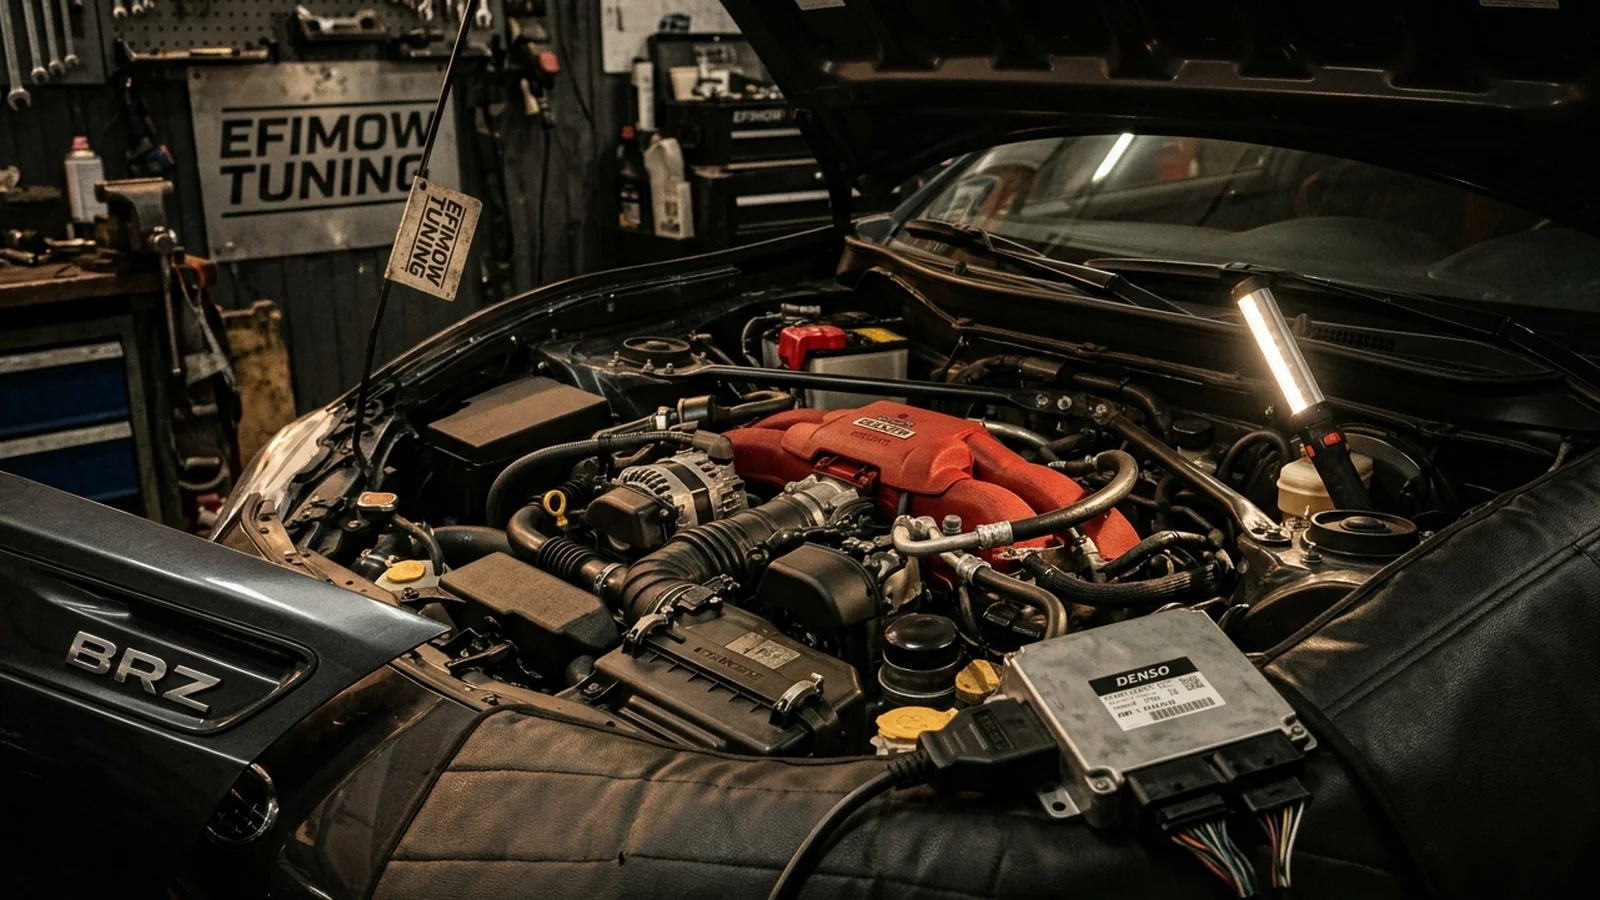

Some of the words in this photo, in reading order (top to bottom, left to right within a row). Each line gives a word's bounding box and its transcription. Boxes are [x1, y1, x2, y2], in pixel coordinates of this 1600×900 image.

[220, 111, 436, 158] EFIMOW
[220, 154, 429, 205] TUNING
[408, 195, 448, 279] TUNING
[425, 199, 463, 288] EFIMOW
[65, 630, 222, 713] BRZ
[1116, 665, 1170, 688] DENSO
